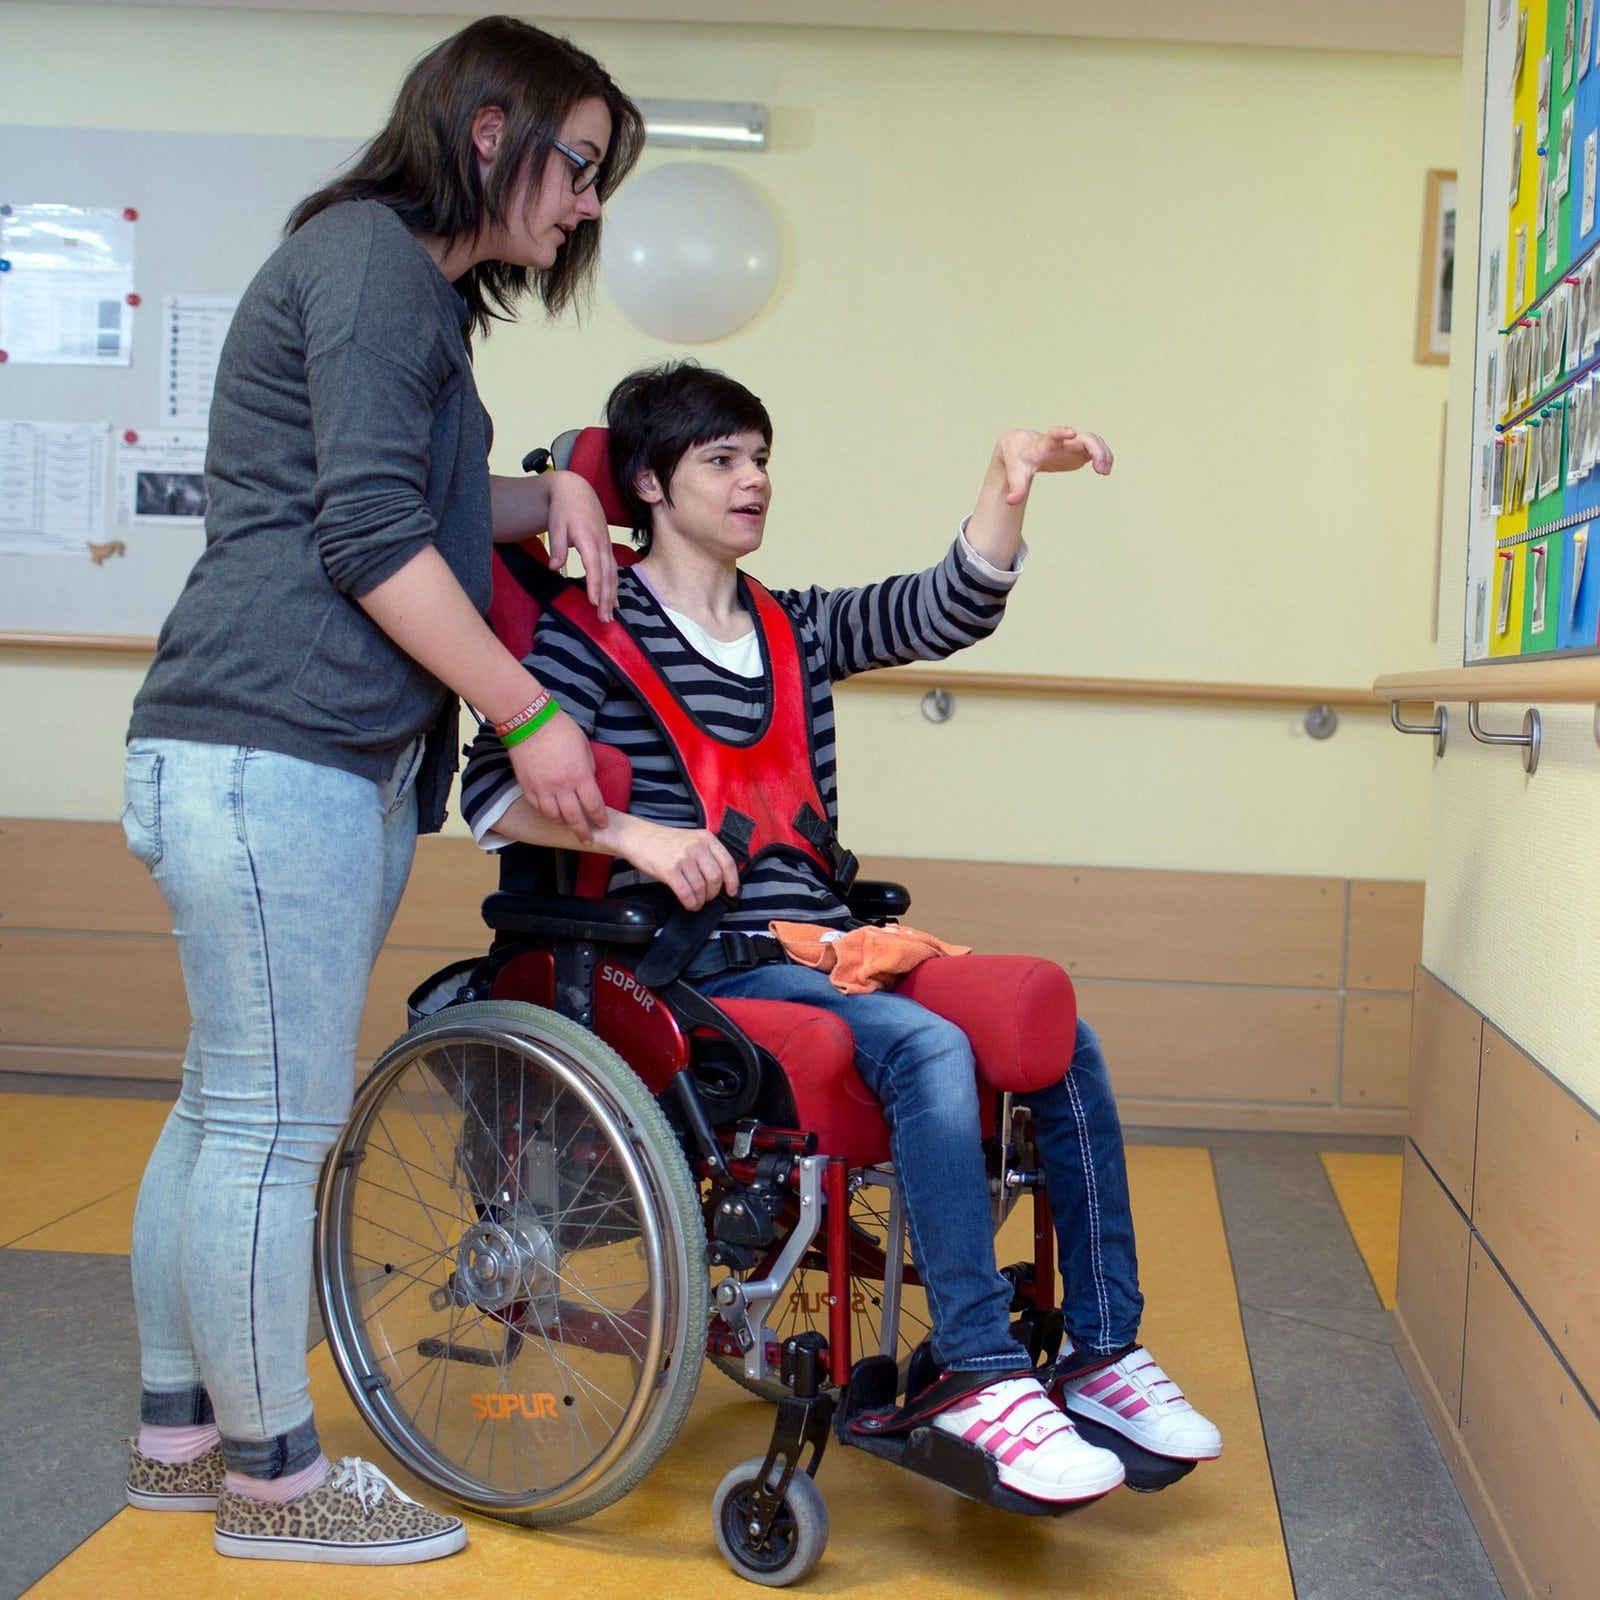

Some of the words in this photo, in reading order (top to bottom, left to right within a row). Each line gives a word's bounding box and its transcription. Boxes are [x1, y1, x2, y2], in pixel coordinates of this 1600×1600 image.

[524, 694, 548, 718] ROCKT
[602, 965, 654, 1012] SOPUR
[470, 1392, 558, 1419] SOPUR
